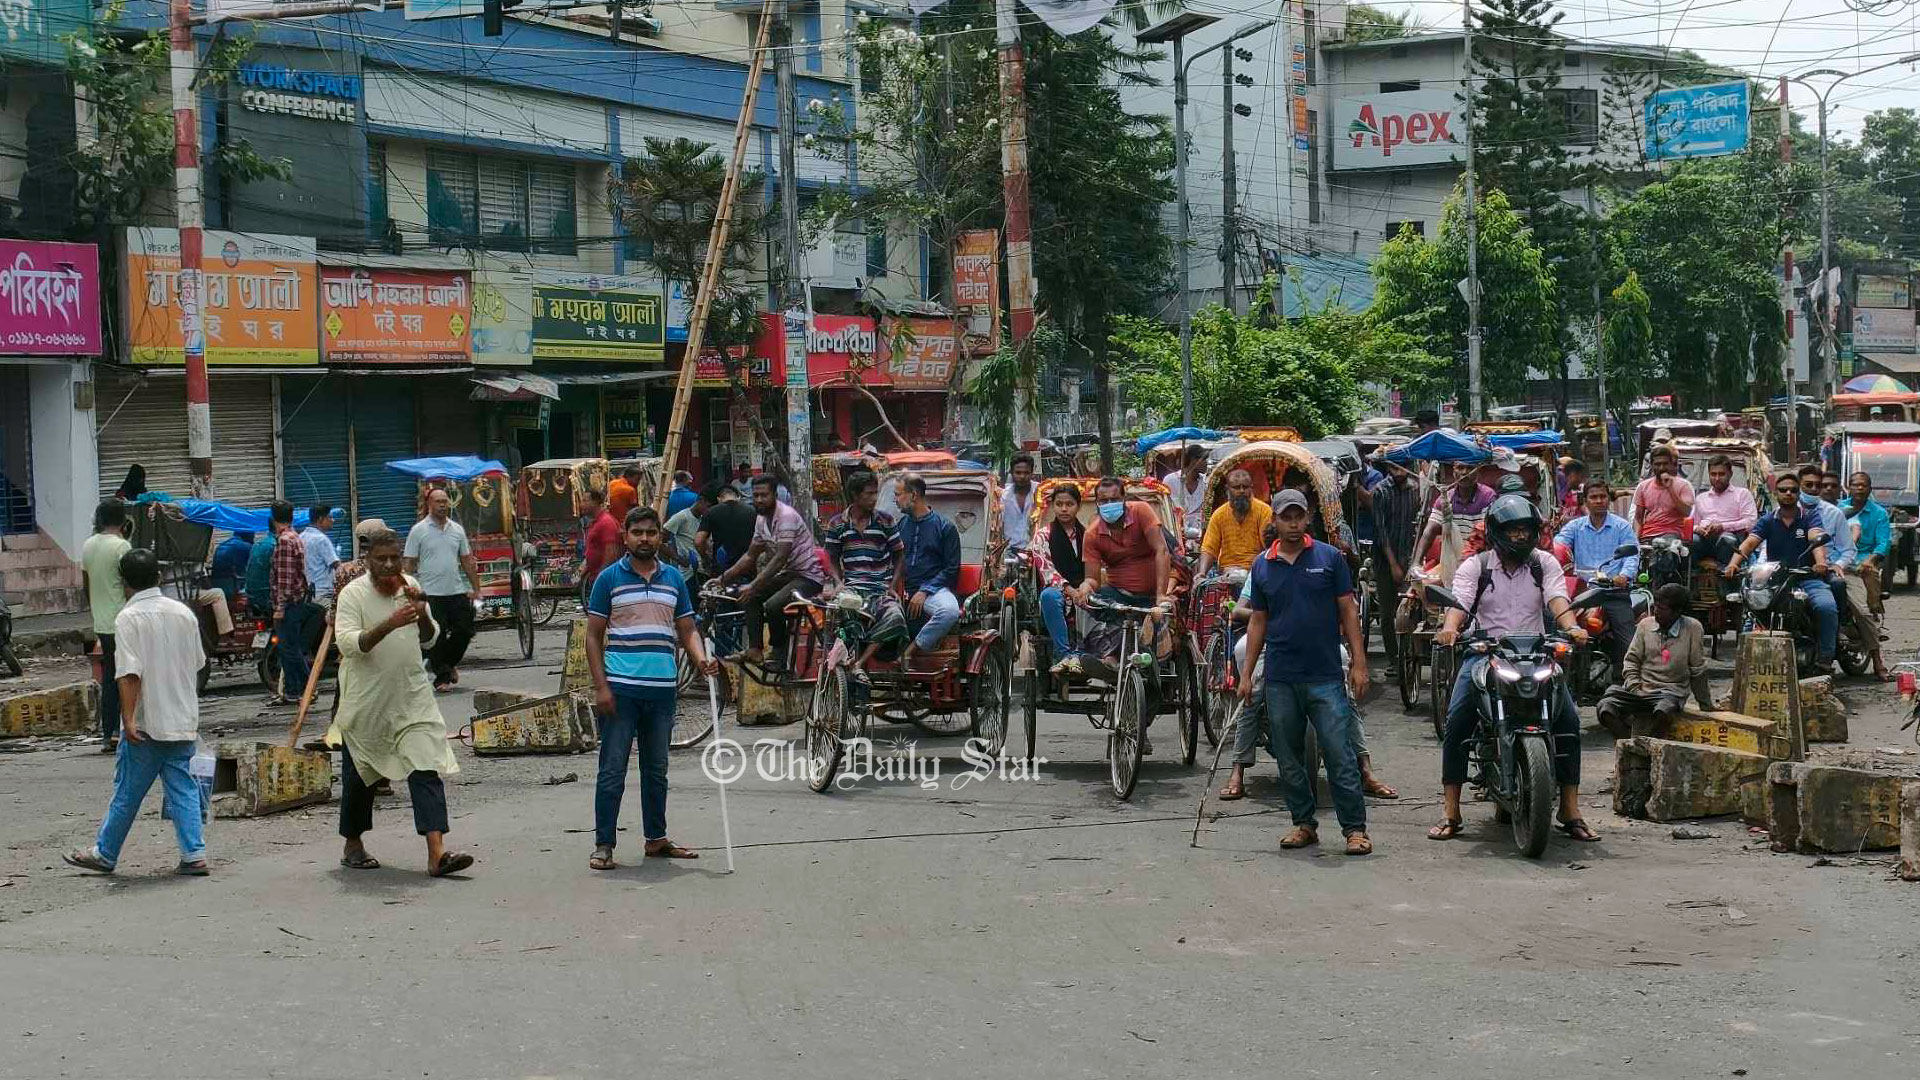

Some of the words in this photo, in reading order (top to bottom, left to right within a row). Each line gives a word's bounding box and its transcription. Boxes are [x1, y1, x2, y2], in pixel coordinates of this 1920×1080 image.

[238, 63, 360, 99] WORKSPACE
[241, 90, 356, 122] CONFERENCE
[1691, 91, 1741, 114] পরিষদ
[1349, 104, 1450, 156] Apex
[1691, 113, 1738, 134] বাংলো
[0, 252, 83, 326] পরিবহন
[236, 267, 301, 311] আলী
[323, 271, 374, 309] আদি
[374, 283, 424, 307] মহরম
[426, 276, 466, 308] আলী
[548, 299, 607, 325] মহরম
[611, 299, 657, 325] আলী
[1750, 664, 1788, 676] BUILD
[1750, 682, 1788, 694] SAFE
[1700, 728, 1711, 744] SA
